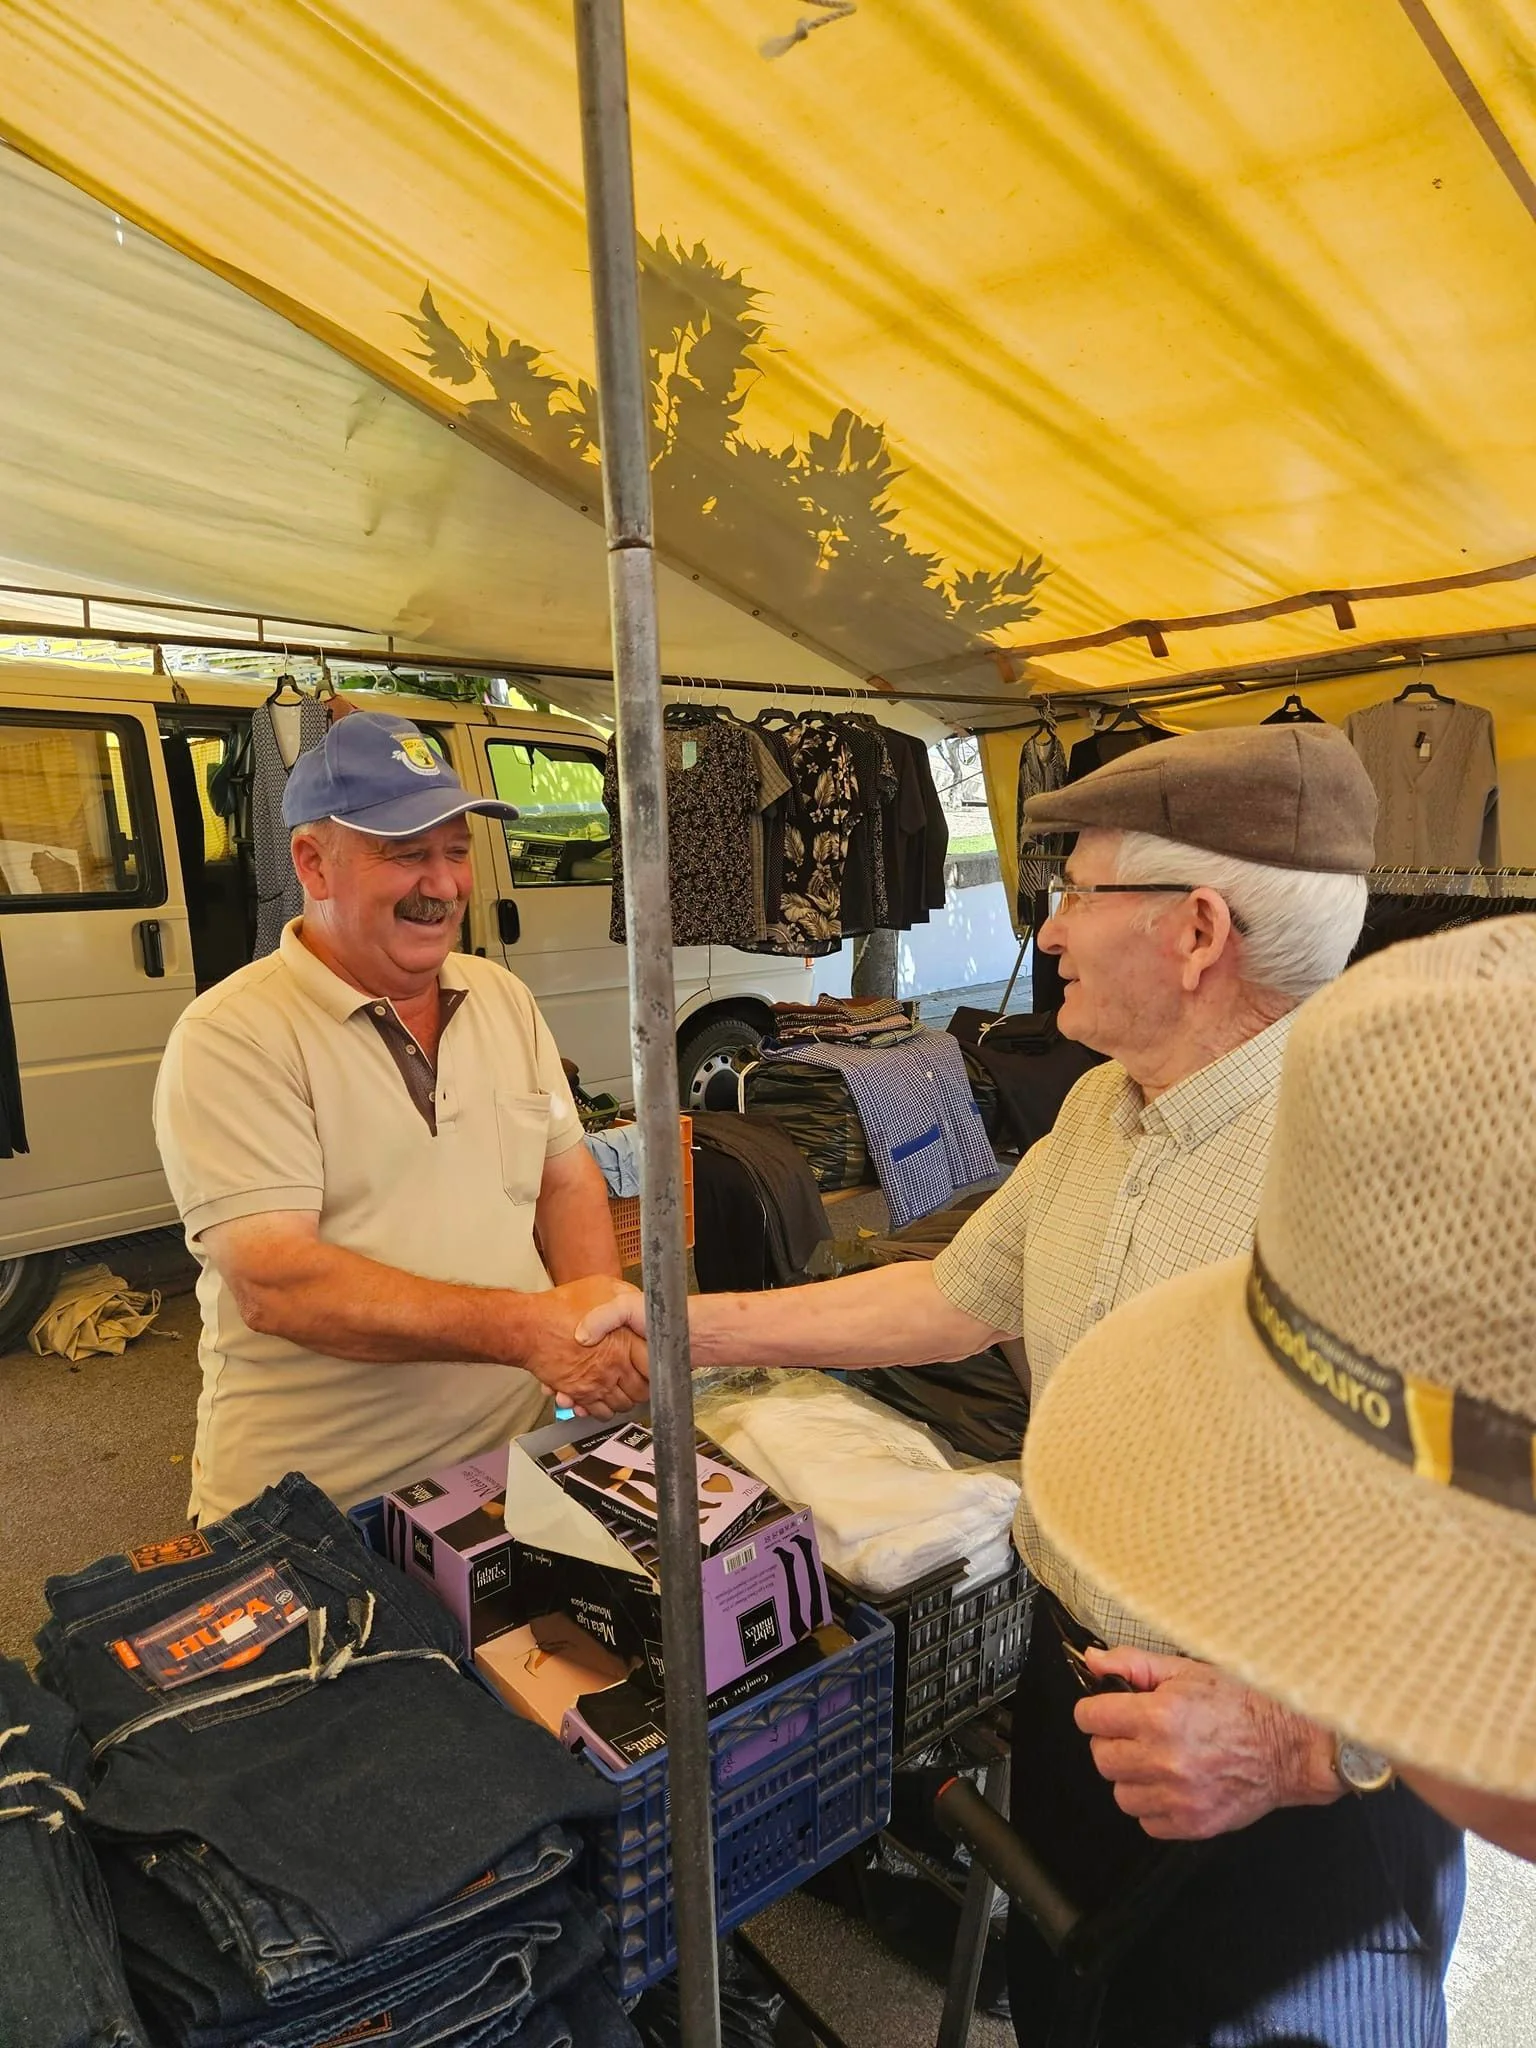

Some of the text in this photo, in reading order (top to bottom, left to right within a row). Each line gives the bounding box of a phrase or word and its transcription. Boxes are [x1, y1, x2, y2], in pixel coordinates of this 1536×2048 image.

[476, 1561, 502, 1582] fabri
[477, 1567, 507, 1588] matex
[570, 1596, 612, 1621] Mousse Opaca
[576, 1611, 617, 1646] Meia Liga
[744, 1615, 774, 1639] matex
[752, 1624, 776, 1647] fabri
[708, 1673, 769, 1710] Comfort Lin
